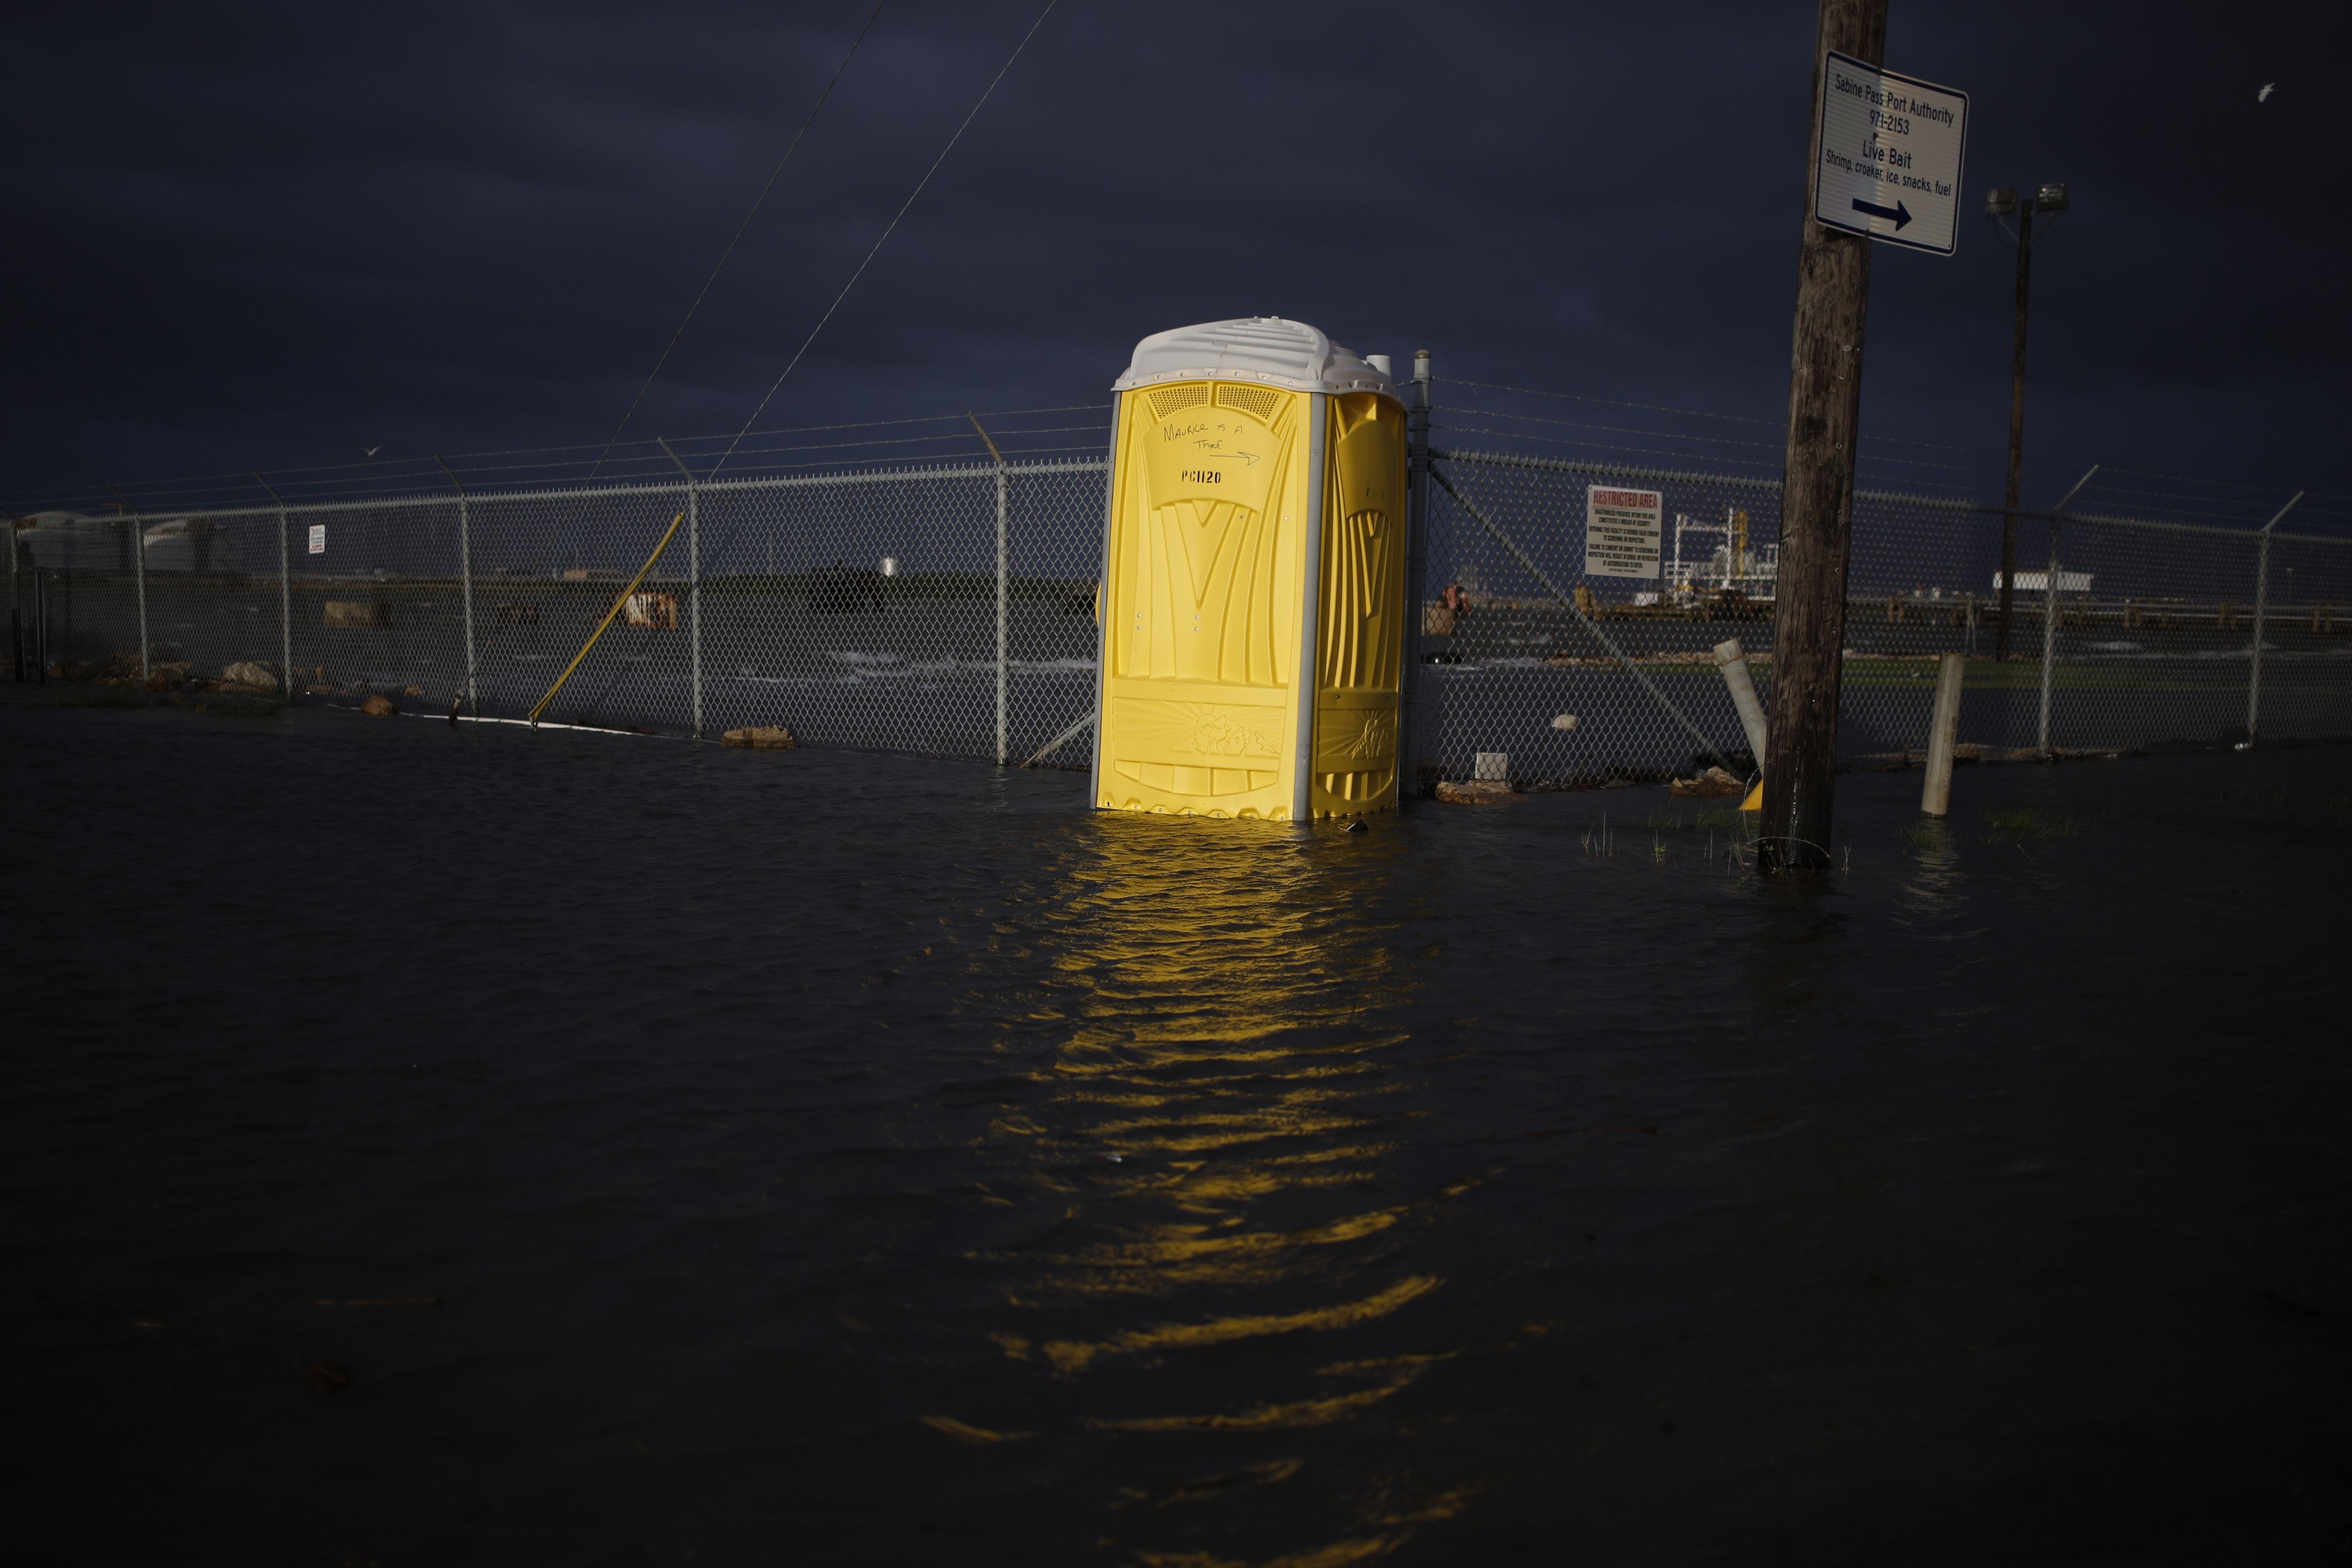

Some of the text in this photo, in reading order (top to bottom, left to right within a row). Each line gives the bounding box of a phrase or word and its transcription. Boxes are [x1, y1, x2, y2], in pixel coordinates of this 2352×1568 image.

[1836, 74, 1954, 128] Sabine Pass Port Authority
[1870, 110, 1909, 135] 971-2153
[1863, 140, 1912, 169] Live Bait
[1826, 149, 1951, 196] Shrimp, croaker, ice, snacks, fuel
[1234, 425, 1242, 433] A
[1193, 440, 1222, 450] Thief
[1182, 470, 1221, 483] PC1120
[1593, 490, 1658, 509] RESTRICTED AREA
